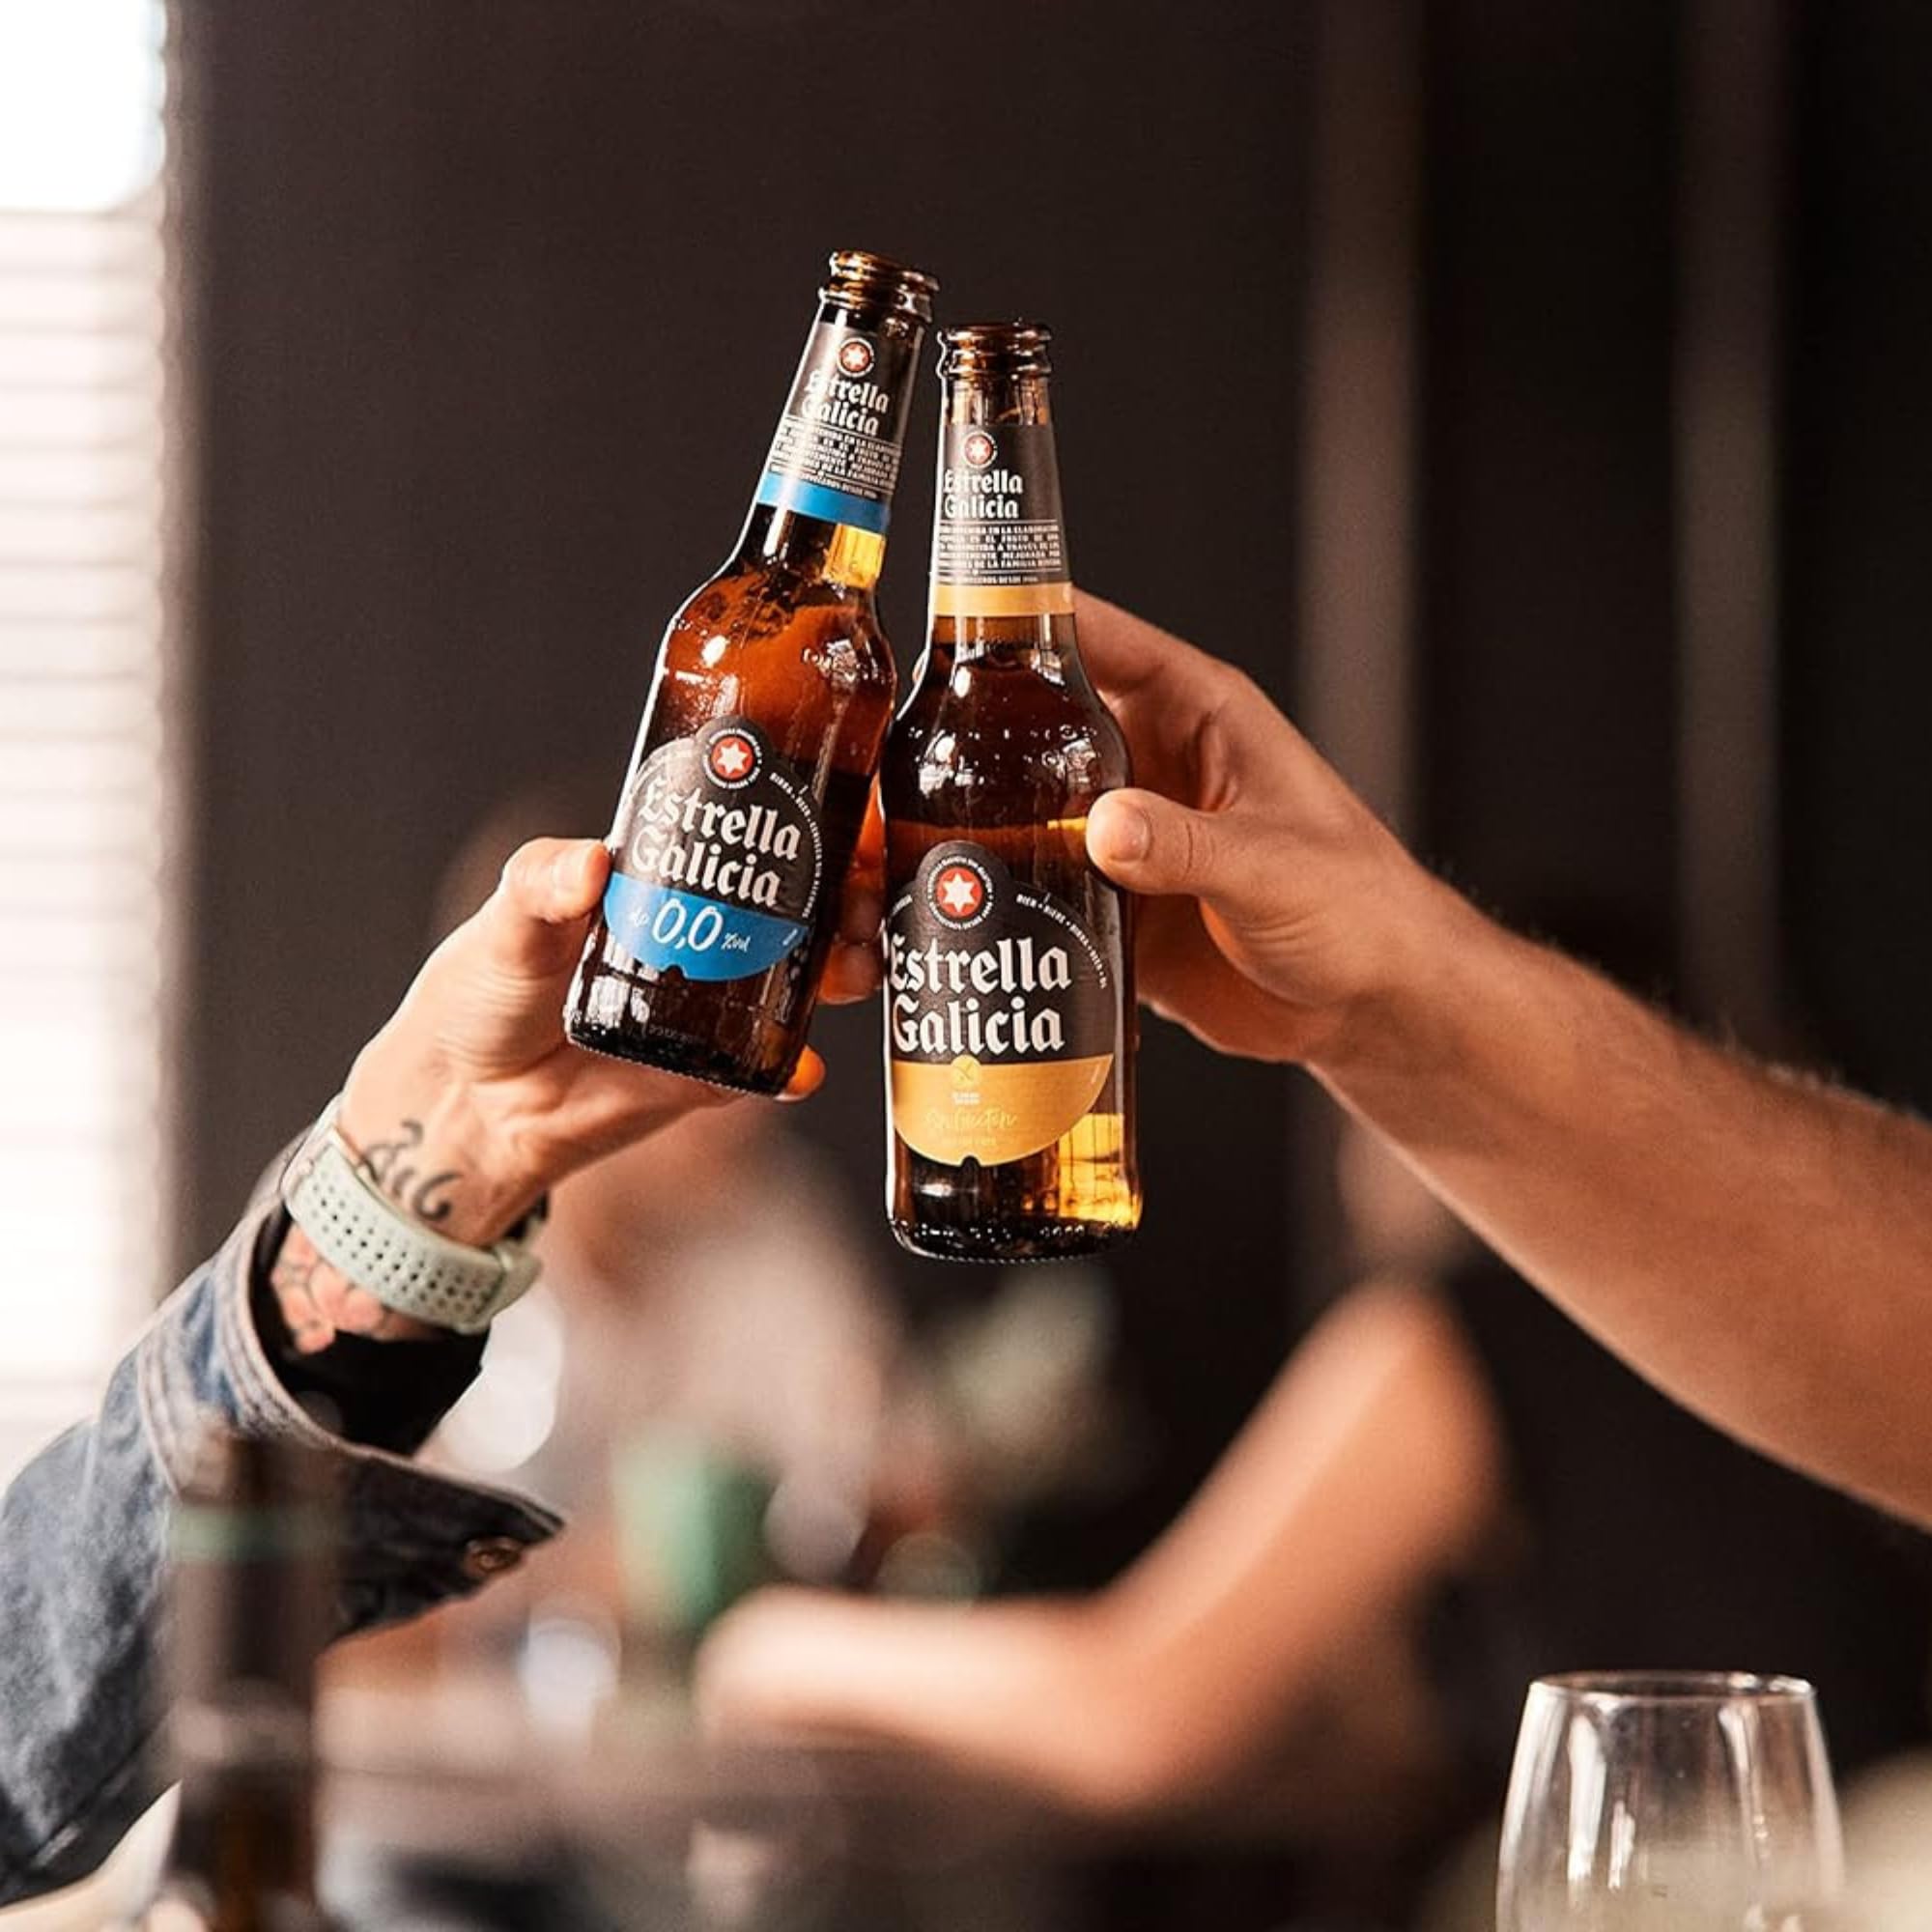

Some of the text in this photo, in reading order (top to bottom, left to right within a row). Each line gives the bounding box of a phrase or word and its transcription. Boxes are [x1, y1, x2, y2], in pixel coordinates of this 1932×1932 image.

[945, 494, 1019, 519] Galicia
[638, 777, 801, 861] Estrella
[632, 825, 781, 907] Galicia
[652, 897, 724, 952] 0,0
[891, 933, 1072, 994] Estrella
[893, 993, 1065, 1055] Galicia
